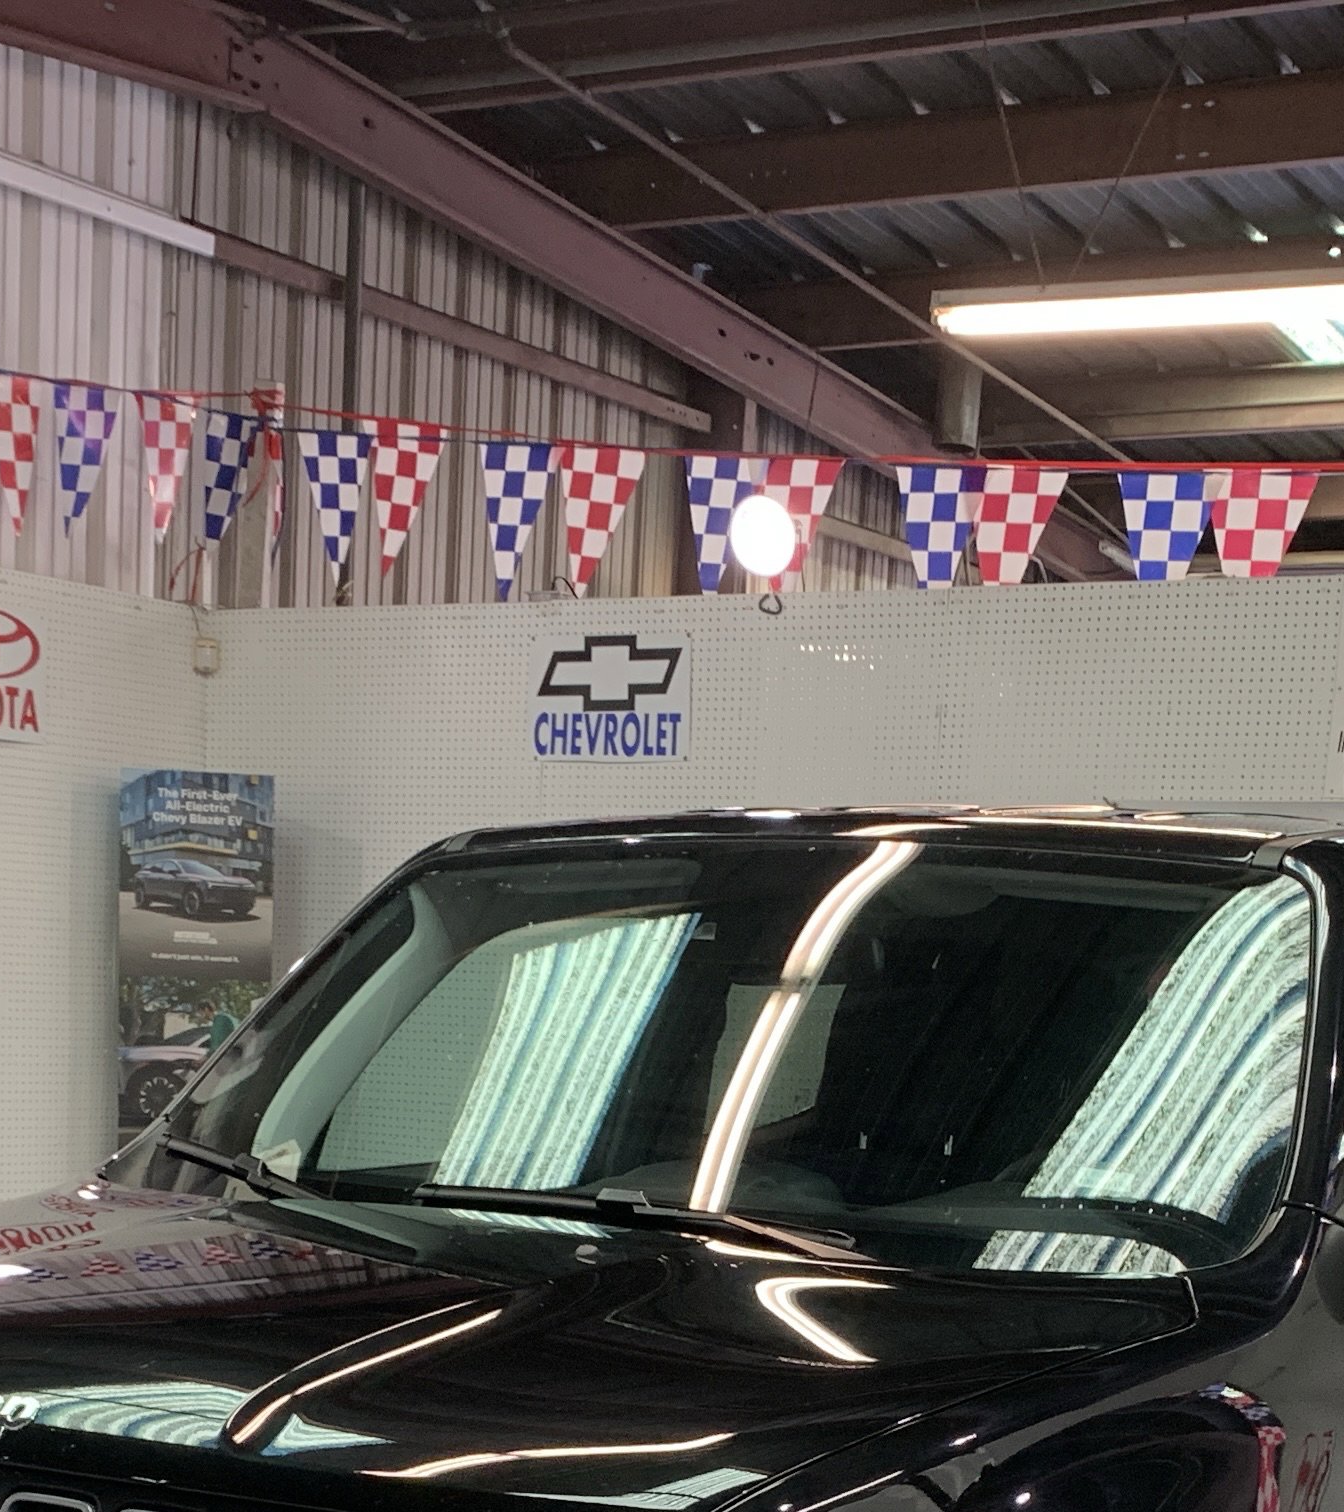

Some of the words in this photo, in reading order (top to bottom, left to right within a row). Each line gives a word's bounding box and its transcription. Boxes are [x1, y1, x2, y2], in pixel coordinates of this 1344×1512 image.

[534, 711, 682, 757] CHEVROLET
[157, 787, 179, 798] The
[165, 801, 230, 813] All-Electric
[152, 811, 187, 825] Chevy
[189, 813, 226, 825] Blazer
[227, 815, 243, 826] EV
